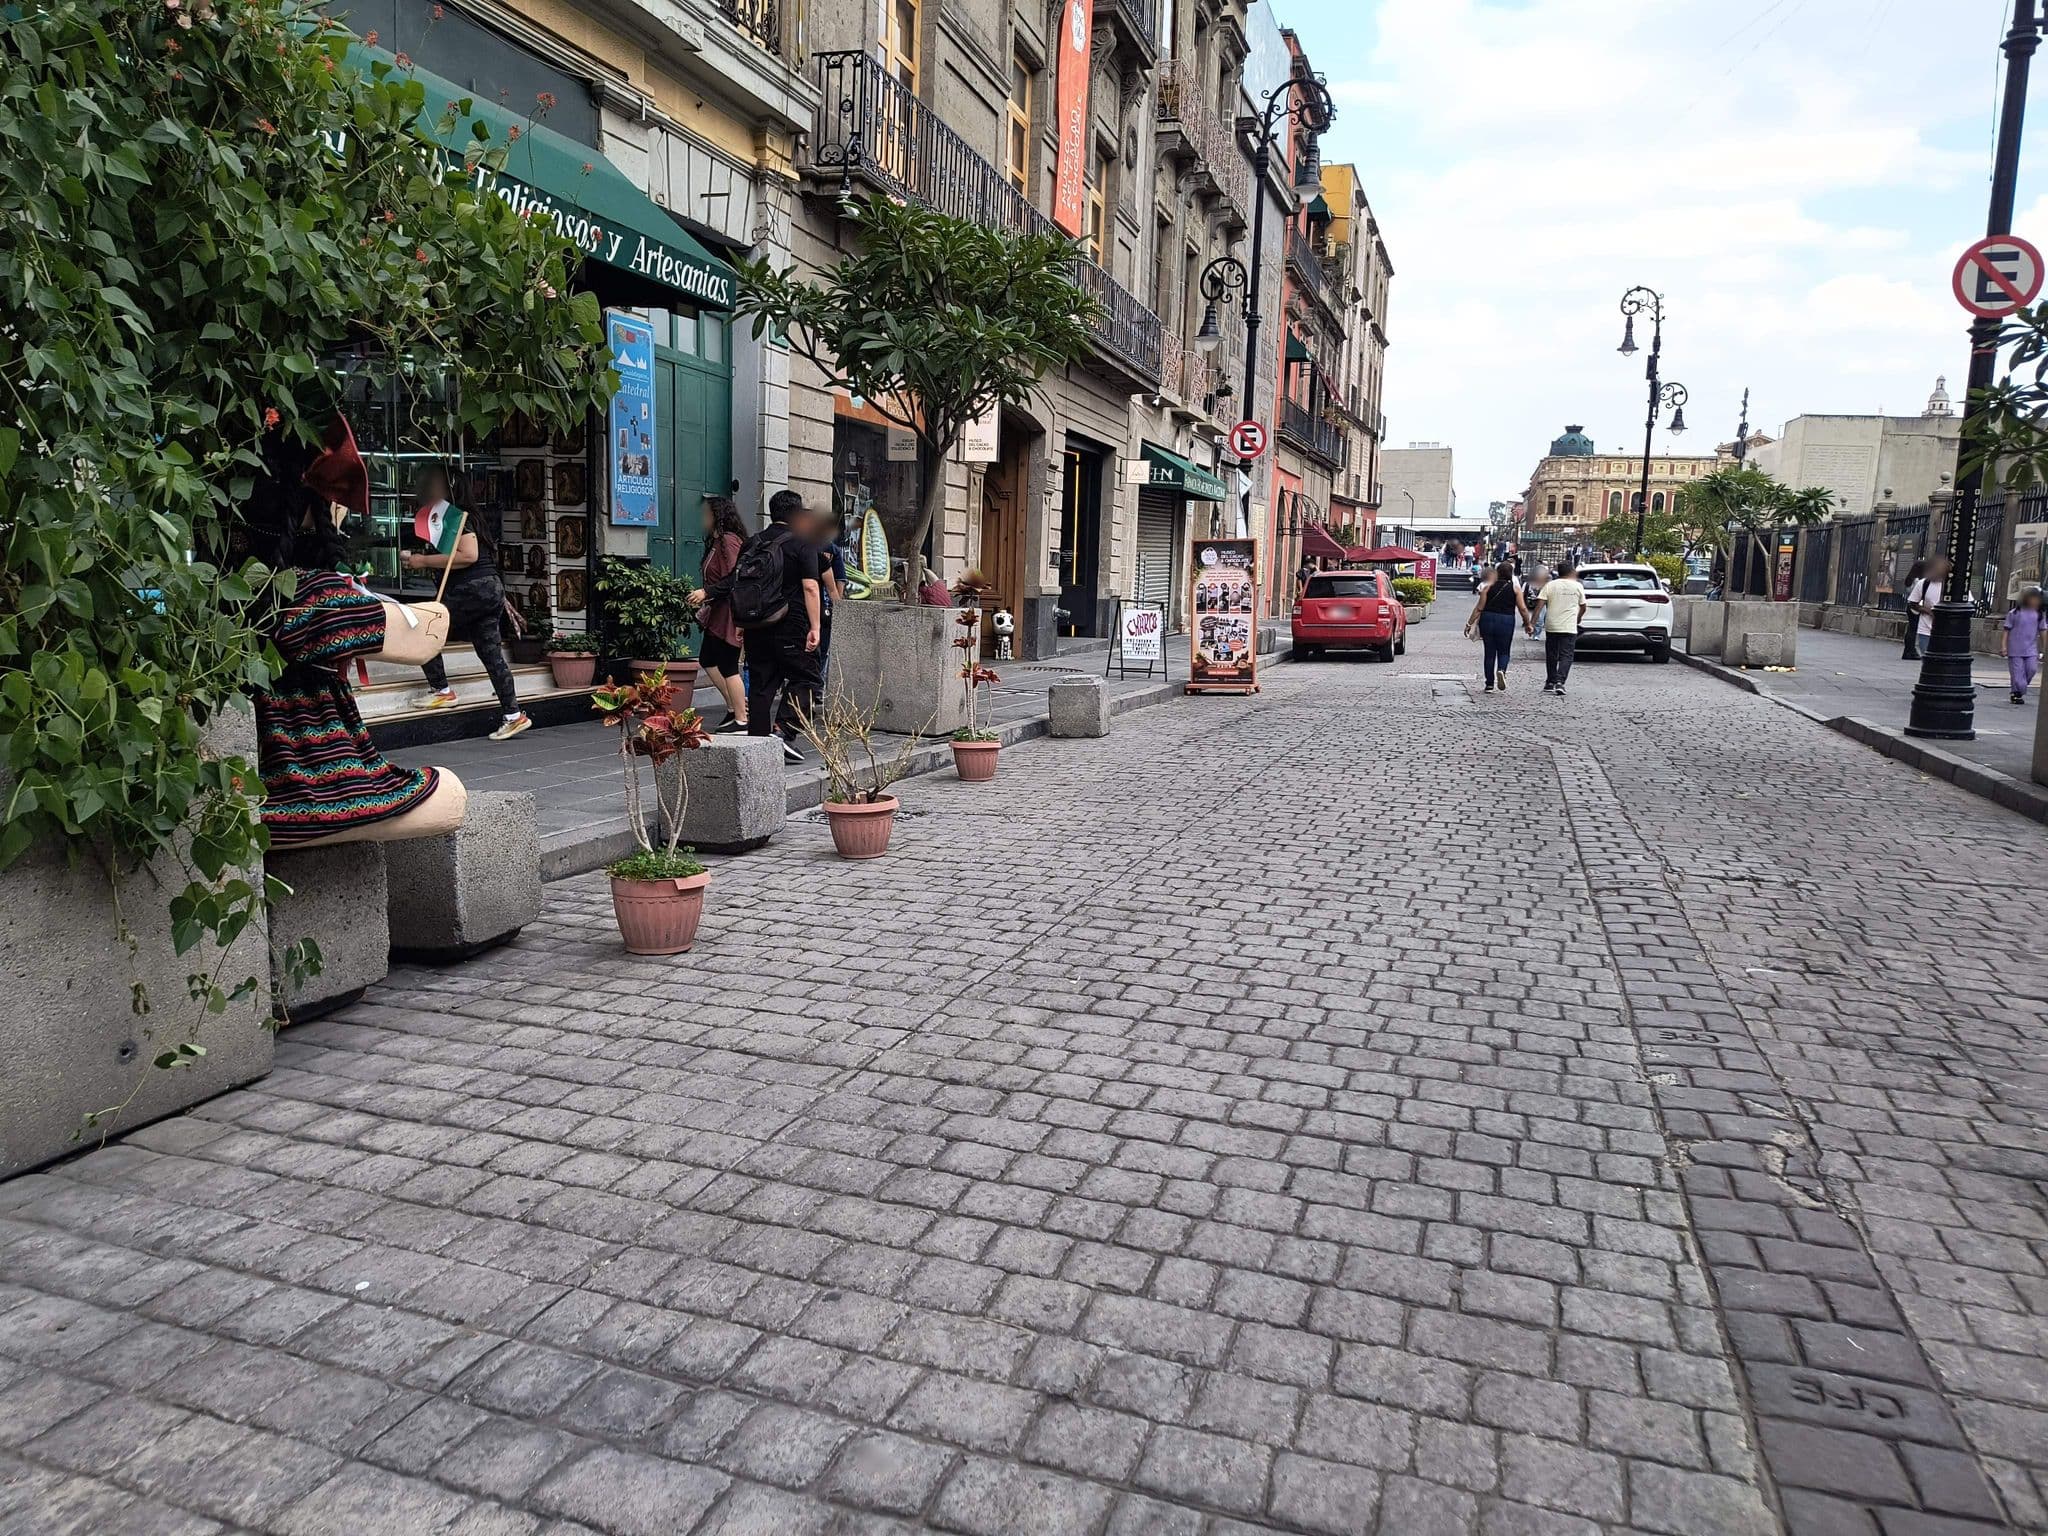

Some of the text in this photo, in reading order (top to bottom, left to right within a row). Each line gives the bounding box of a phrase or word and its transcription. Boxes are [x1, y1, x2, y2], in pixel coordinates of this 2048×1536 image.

[606, 231, 623, 262] y
[629, 235, 730, 306] Artesanias.
[1150, 467, 1174, 480] HN
[618, 475, 653, 487] ARTICULOS
[617, 484, 655, 496] RELIGIOSOS
